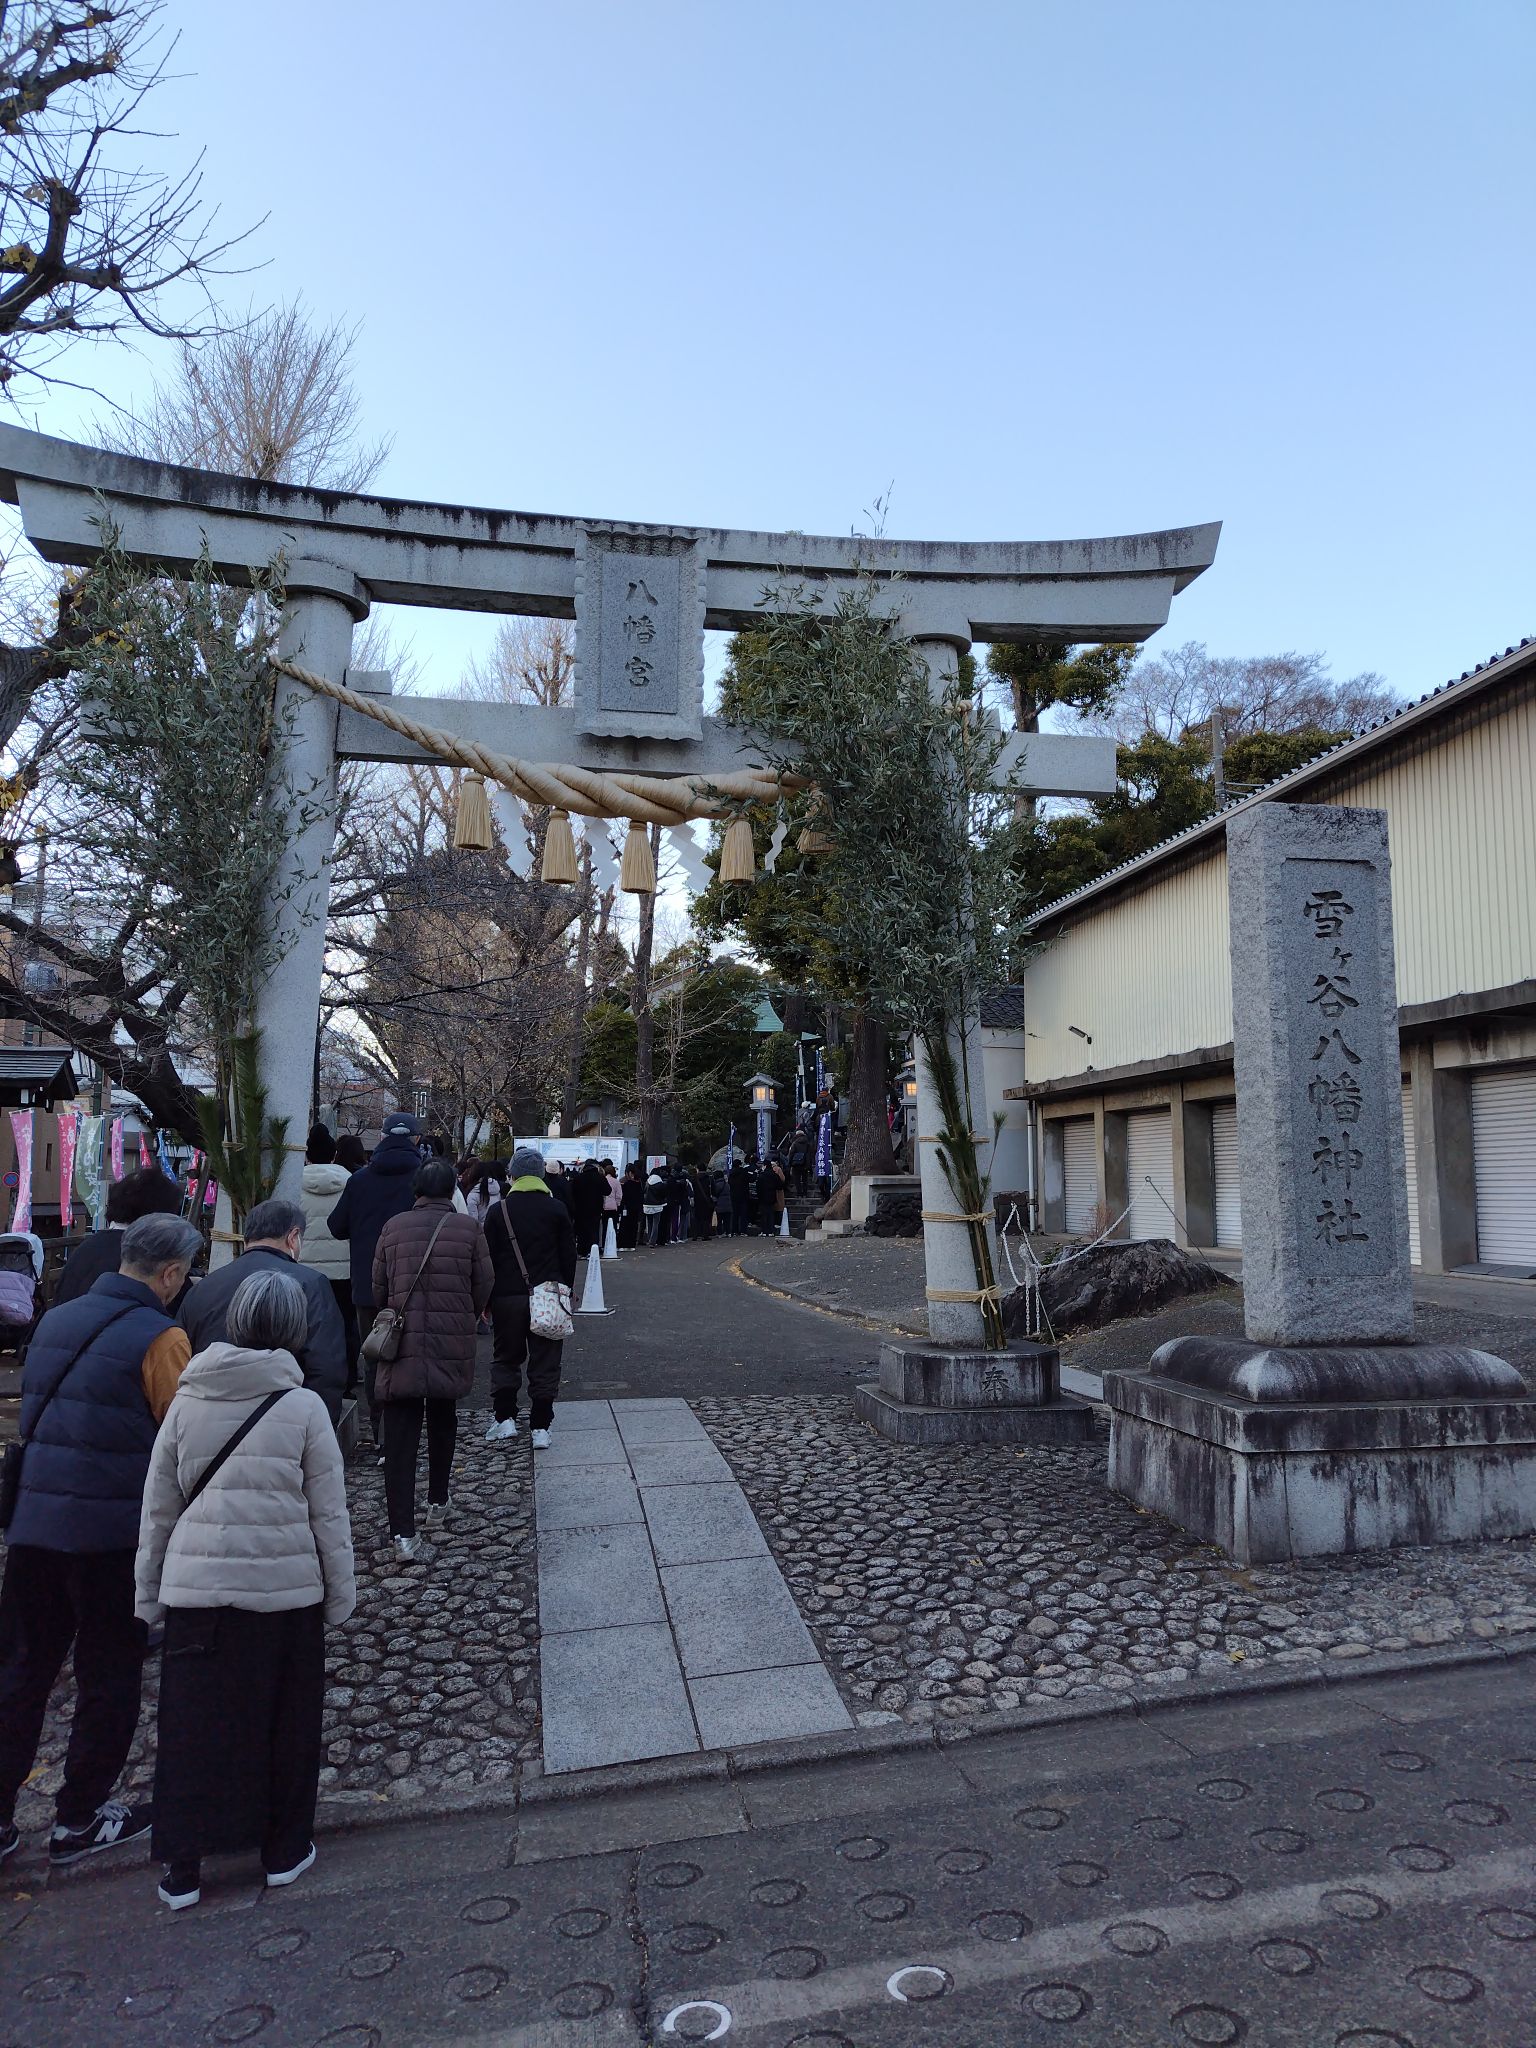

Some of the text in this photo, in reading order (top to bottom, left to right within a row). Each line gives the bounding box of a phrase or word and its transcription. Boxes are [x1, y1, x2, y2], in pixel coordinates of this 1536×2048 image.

[623, 579, 659, 687] 八幡宮
[1302, 889, 1369, 1248] 雪ヶ谷八幡神社
[982, 1366, 1009, 1401] 奉
